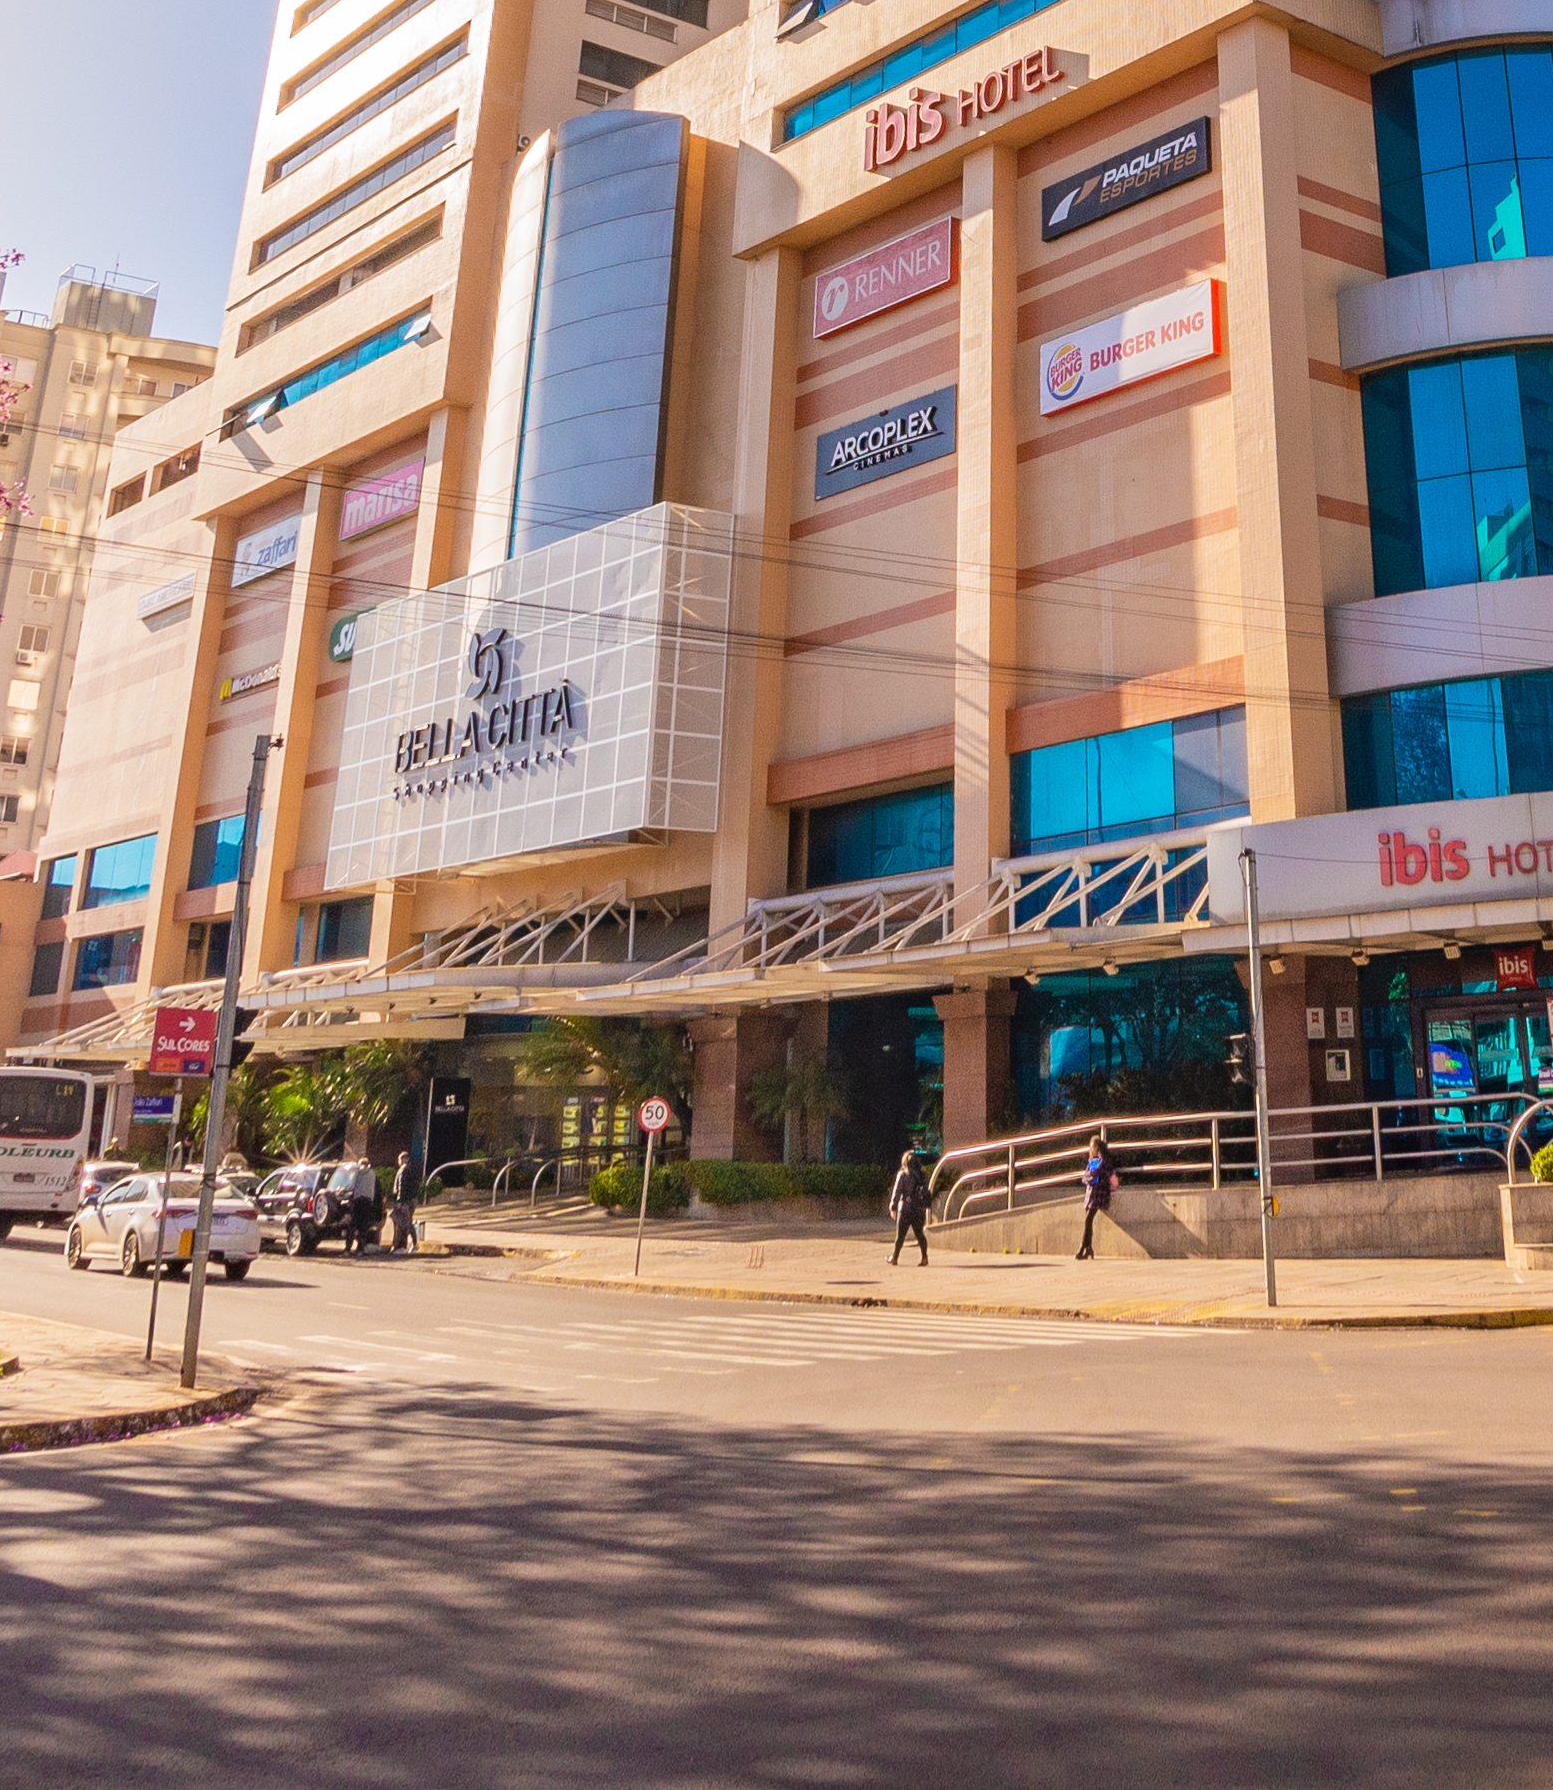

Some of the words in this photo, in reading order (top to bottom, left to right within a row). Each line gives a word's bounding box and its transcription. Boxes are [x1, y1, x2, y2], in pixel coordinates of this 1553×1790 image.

[864, 87, 946, 172] ibis
[957, 45, 1065, 127] HOTEL
[1099, 148, 1198, 204] ESPORTES
[855, 240, 941, 302] RENNER
[1050, 347, 1082, 378] BURGER
[1090, 329, 1157, 372] BURGER
[1160, 311, 1205, 345] KING
[1051, 358, 1083, 392] KING
[831, 405, 936, 467] ARCOPLEX
[852, 443, 912, 471] CINEMAS
[344, 473, 418, 533] marisa
[257, 529, 298, 566] zaffari
[1378, 828, 1471, 887] ibis
[1498, 955, 1529, 976] ibis
[645, 1105, 665, 1121] 50
[44, 1175, 68, 1187] 1512
